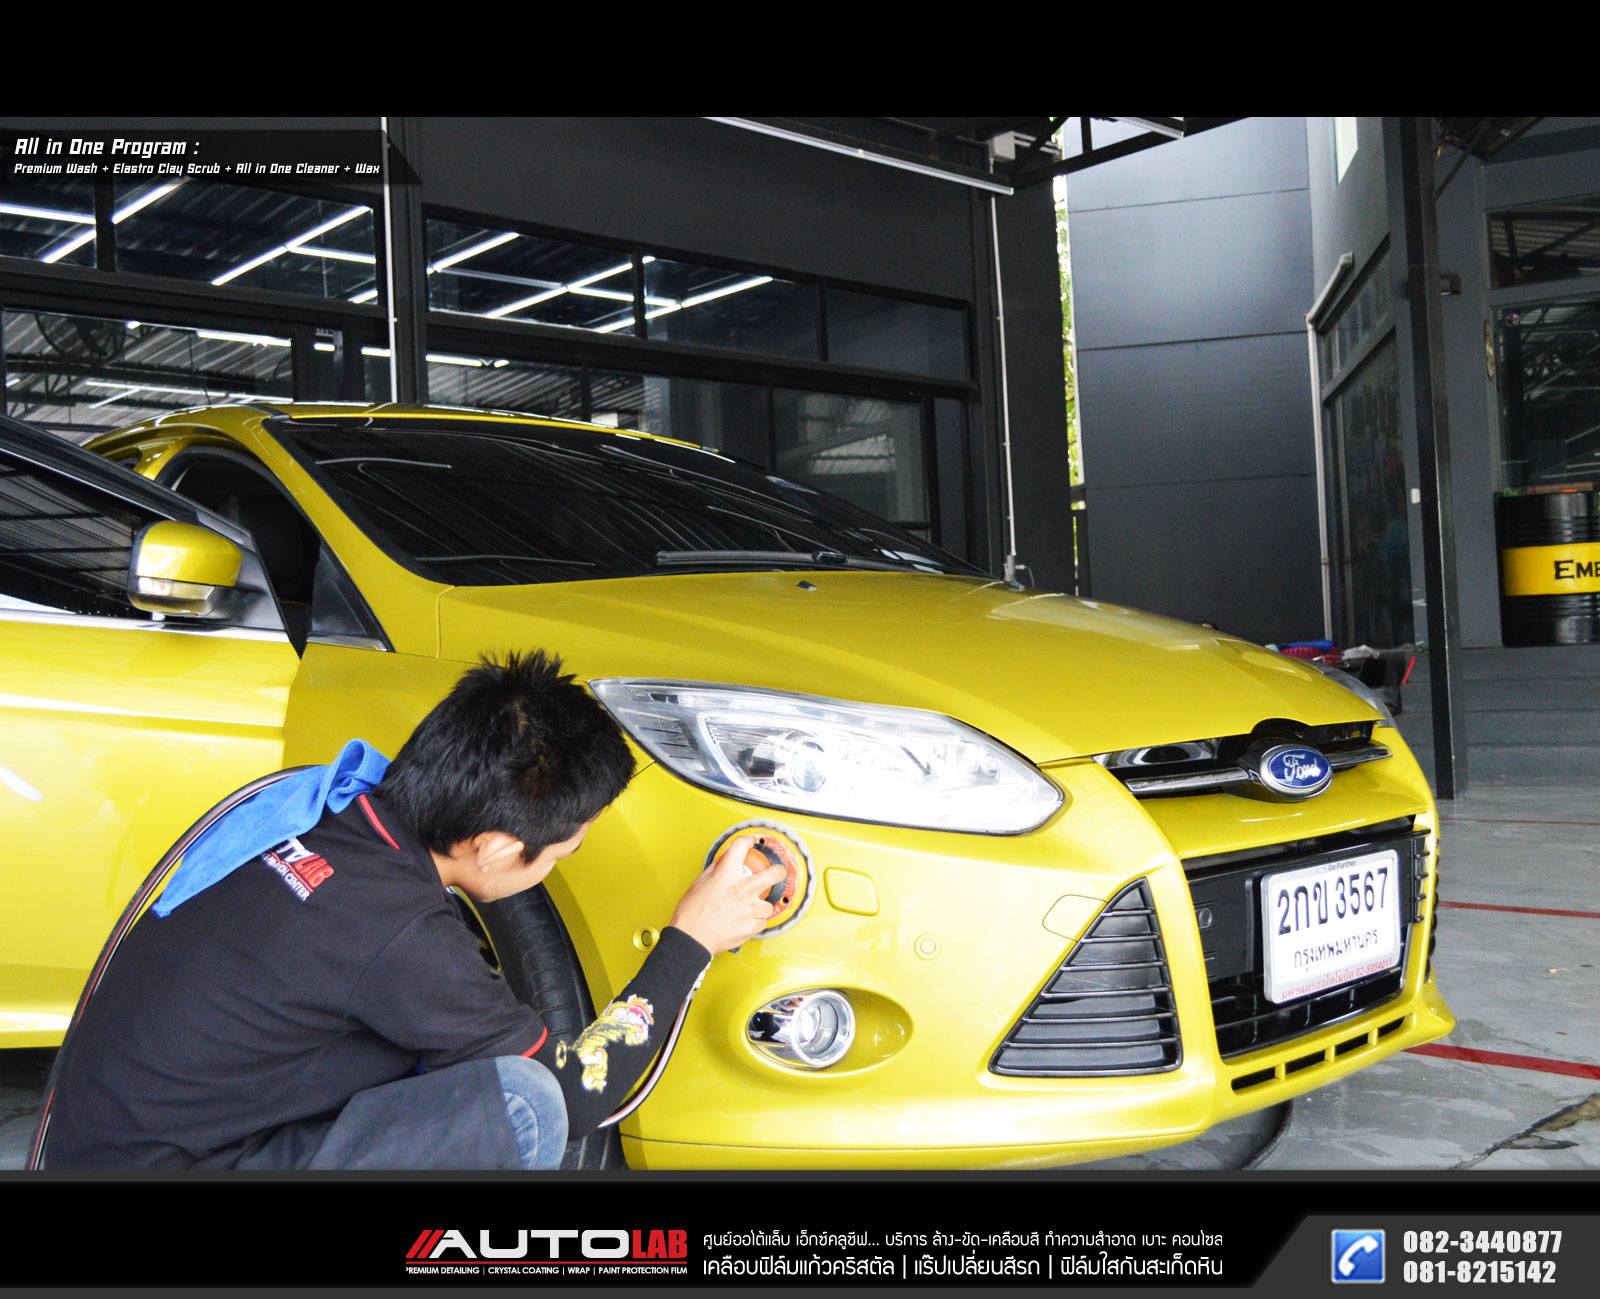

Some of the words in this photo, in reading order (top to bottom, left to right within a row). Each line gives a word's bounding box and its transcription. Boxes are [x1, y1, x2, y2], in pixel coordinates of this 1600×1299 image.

[1282, 754, 1321, 781] Ford
[1277, 880, 1328, 935] 2กข
[1336, 866, 1388, 919] 3567
